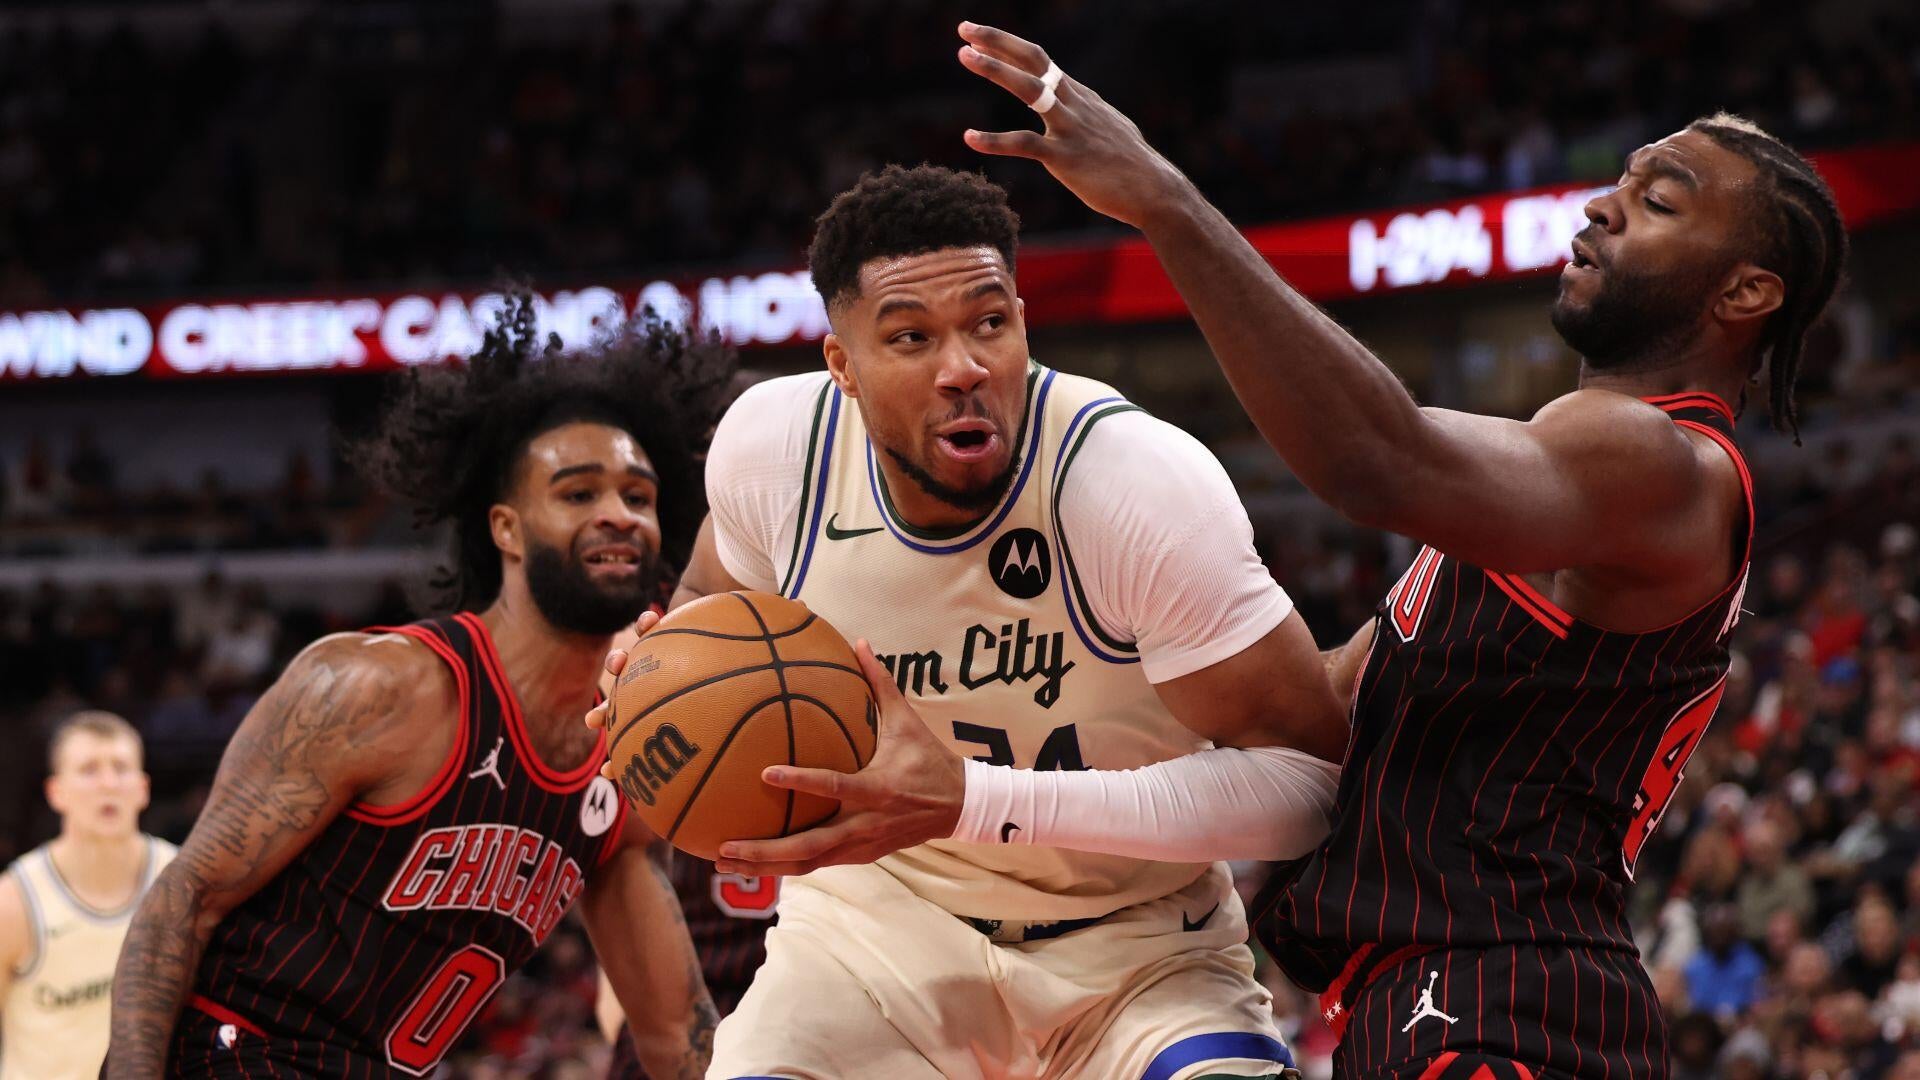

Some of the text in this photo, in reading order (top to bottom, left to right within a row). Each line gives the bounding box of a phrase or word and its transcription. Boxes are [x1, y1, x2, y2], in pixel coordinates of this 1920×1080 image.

[959, 618, 1075, 709] City
[382, 823, 585, 947] CHICAG
[385, 943, 506, 1077] 0
